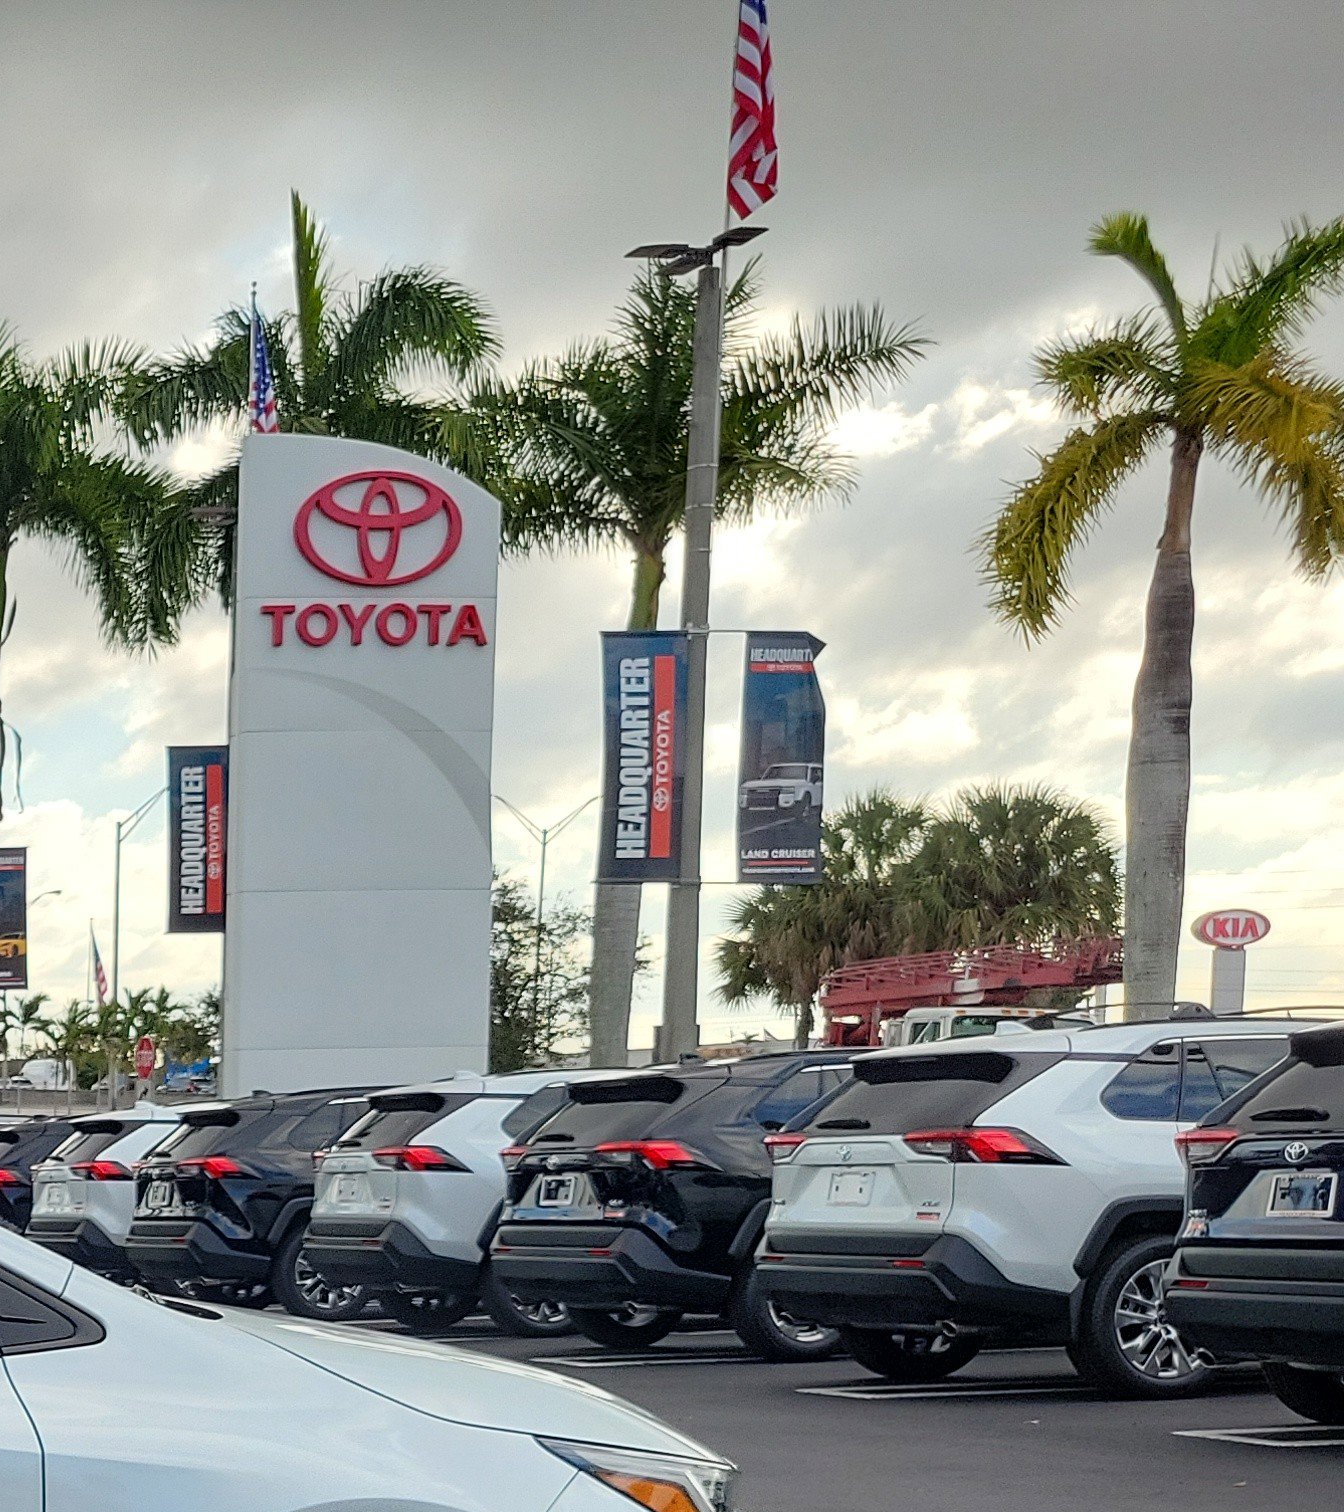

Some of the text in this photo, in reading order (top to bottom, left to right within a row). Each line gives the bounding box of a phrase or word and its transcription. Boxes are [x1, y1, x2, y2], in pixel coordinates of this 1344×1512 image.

[260, 603, 487, 647] TOYOTA
[615, 657, 652, 858] HEADQUARTER
[655, 710, 671, 786] TOYOTA
[180, 765, 206, 914] HEADQUARTER
[209, 805, 221, 859] TOYOTA
[741, 848, 815, 858] LAND CRUISER
[1212, 917, 1260, 938] KIA
